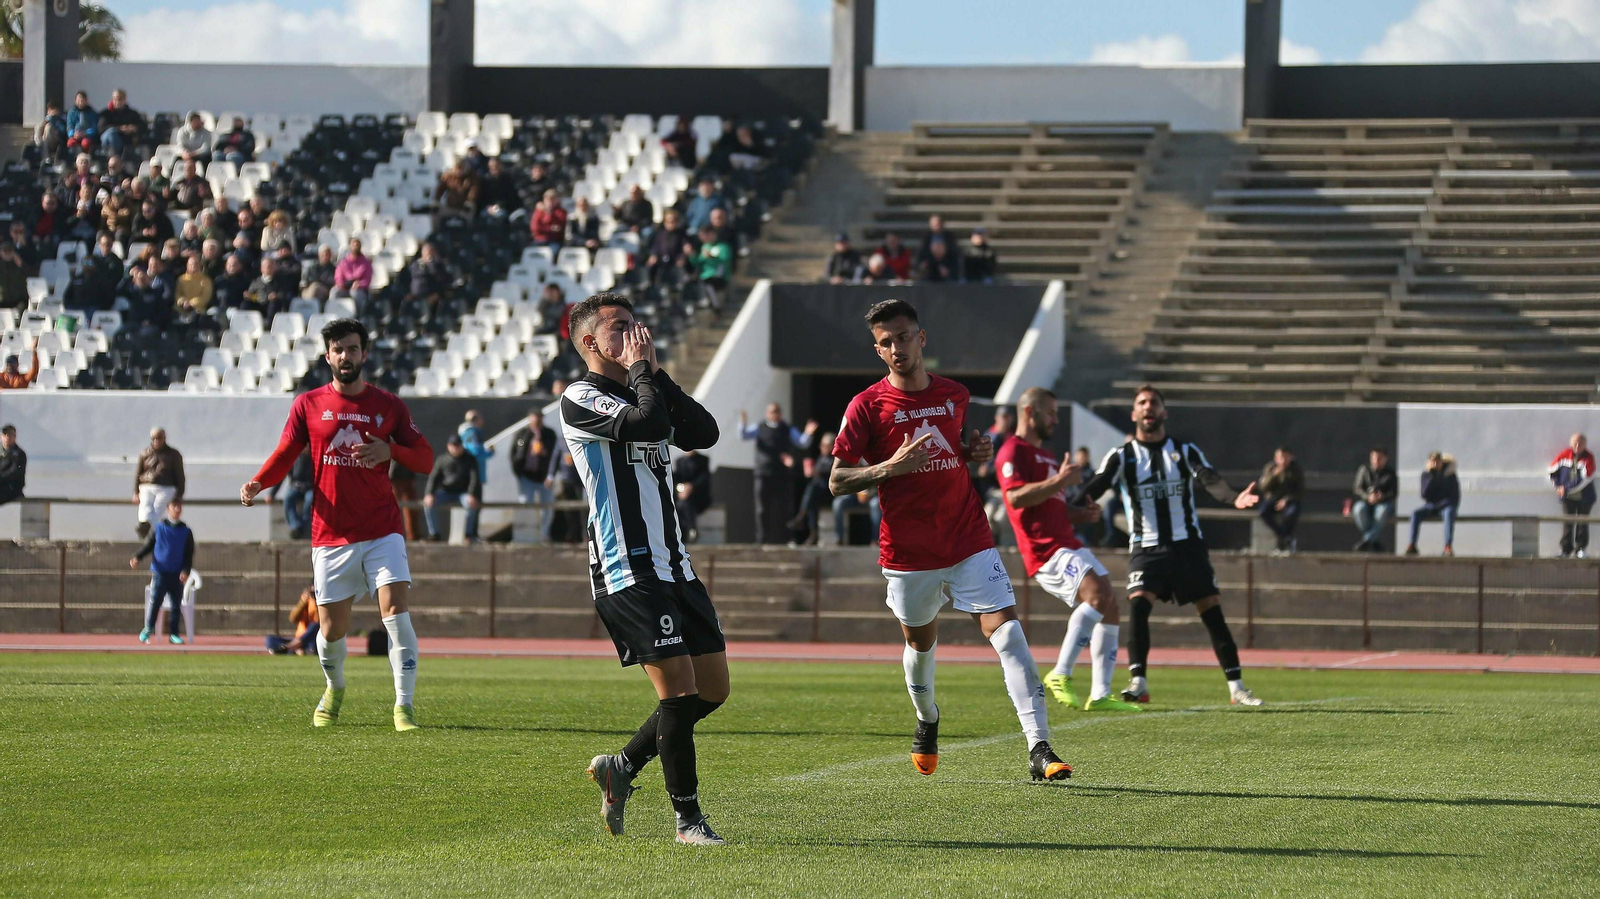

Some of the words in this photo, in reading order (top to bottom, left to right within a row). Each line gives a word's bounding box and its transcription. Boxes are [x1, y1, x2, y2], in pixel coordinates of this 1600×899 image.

[336, 412, 371, 423] VILLARROBLEDO
[908, 406, 946, 419] VILLARROBLEDO
[323, 454, 374, 468] PARCITAN
[911, 456, 960, 473] CITANK
[1127, 570, 1144, 583] 17
[660, 614, 674, 635] 9
[654, 635, 683, 647] LEGEA
